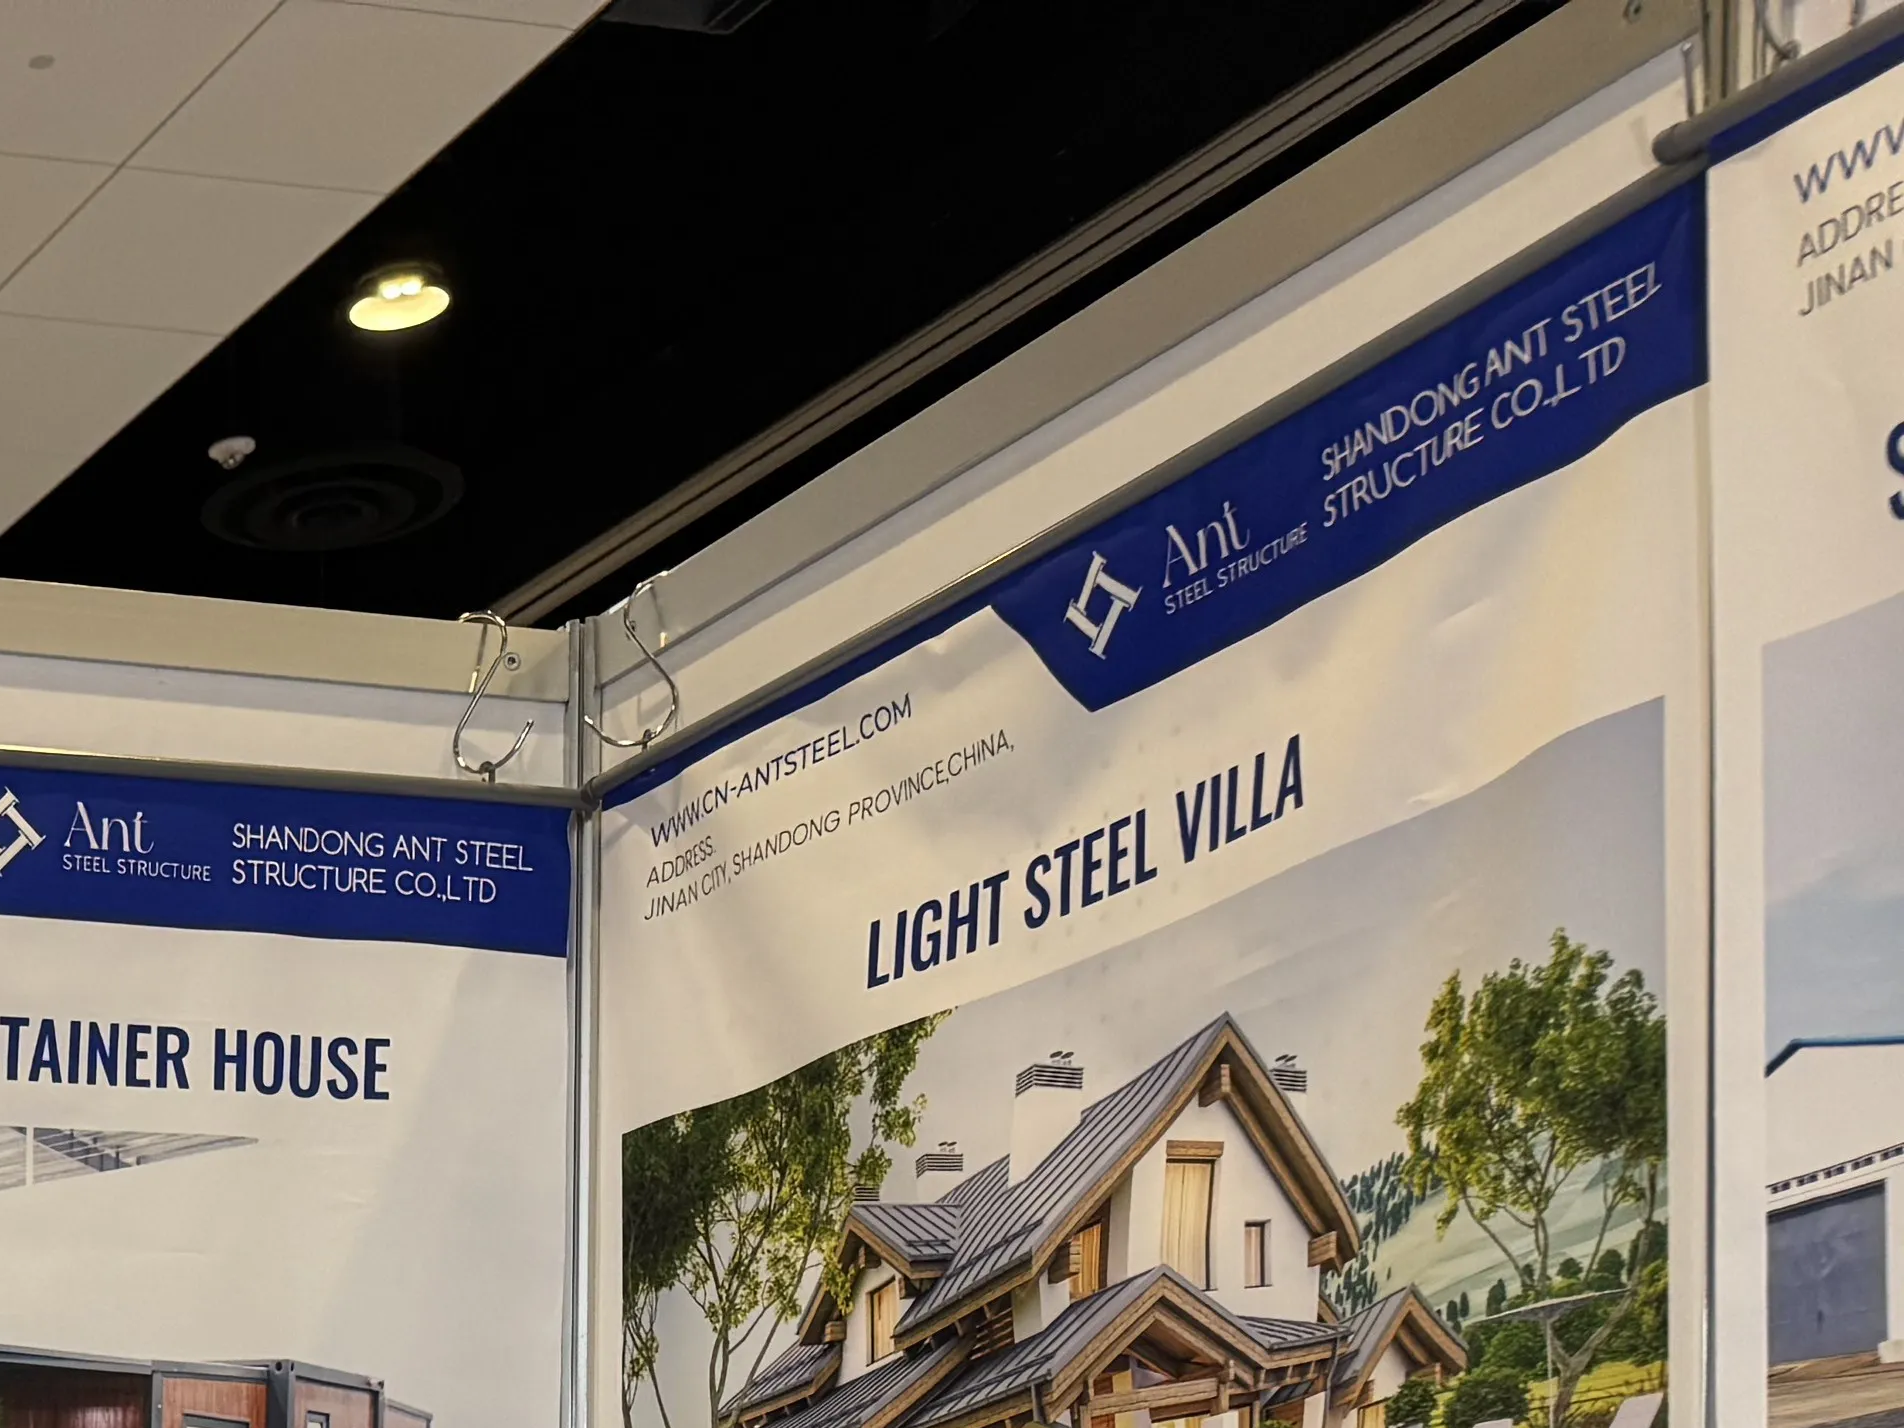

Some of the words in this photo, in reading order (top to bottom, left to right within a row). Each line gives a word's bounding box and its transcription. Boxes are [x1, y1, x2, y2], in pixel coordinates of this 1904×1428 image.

[1798, 239, 1894, 317] JINAN
[1321, 362, 1480, 481] SHANDONG
[1484, 317, 1551, 388] ANT
[1561, 261, 1662, 343] STEEL
[1322, 408, 1485, 527] STRUCTURE
[1162, 500, 1250, 589] Ant
[1164, 577, 1213, 615] STEEL
[1217, 521, 1308, 588] STRUCTURE
[651, 692, 913, 847] WWW.CN-ANTSTEEL.COM
[62, 854, 111, 874] STEEL
[117, 858, 211, 882] STRUCTURE
[63, 801, 154, 854] Ant
[232, 822, 384, 858] SHANDONG
[392, 834, 448, 864] ANT
[455, 840, 534, 871] STEEL
[644, 883, 699, 921] JINAN
[702, 862, 731, 896] CITY,
[733, 810, 840, 876] SHANDONG
[848, 728, 1015, 825] PROVINCE,CHINA,
[866, 874, 1009, 990] LIGHT
[1024, 806, 1159, 931] STEEL
[1176, 734, 1305, 865] VILLA
[232, 859, 387, 894] STRUCTURE
[212, 1025, 391, 1101] HOUSE
